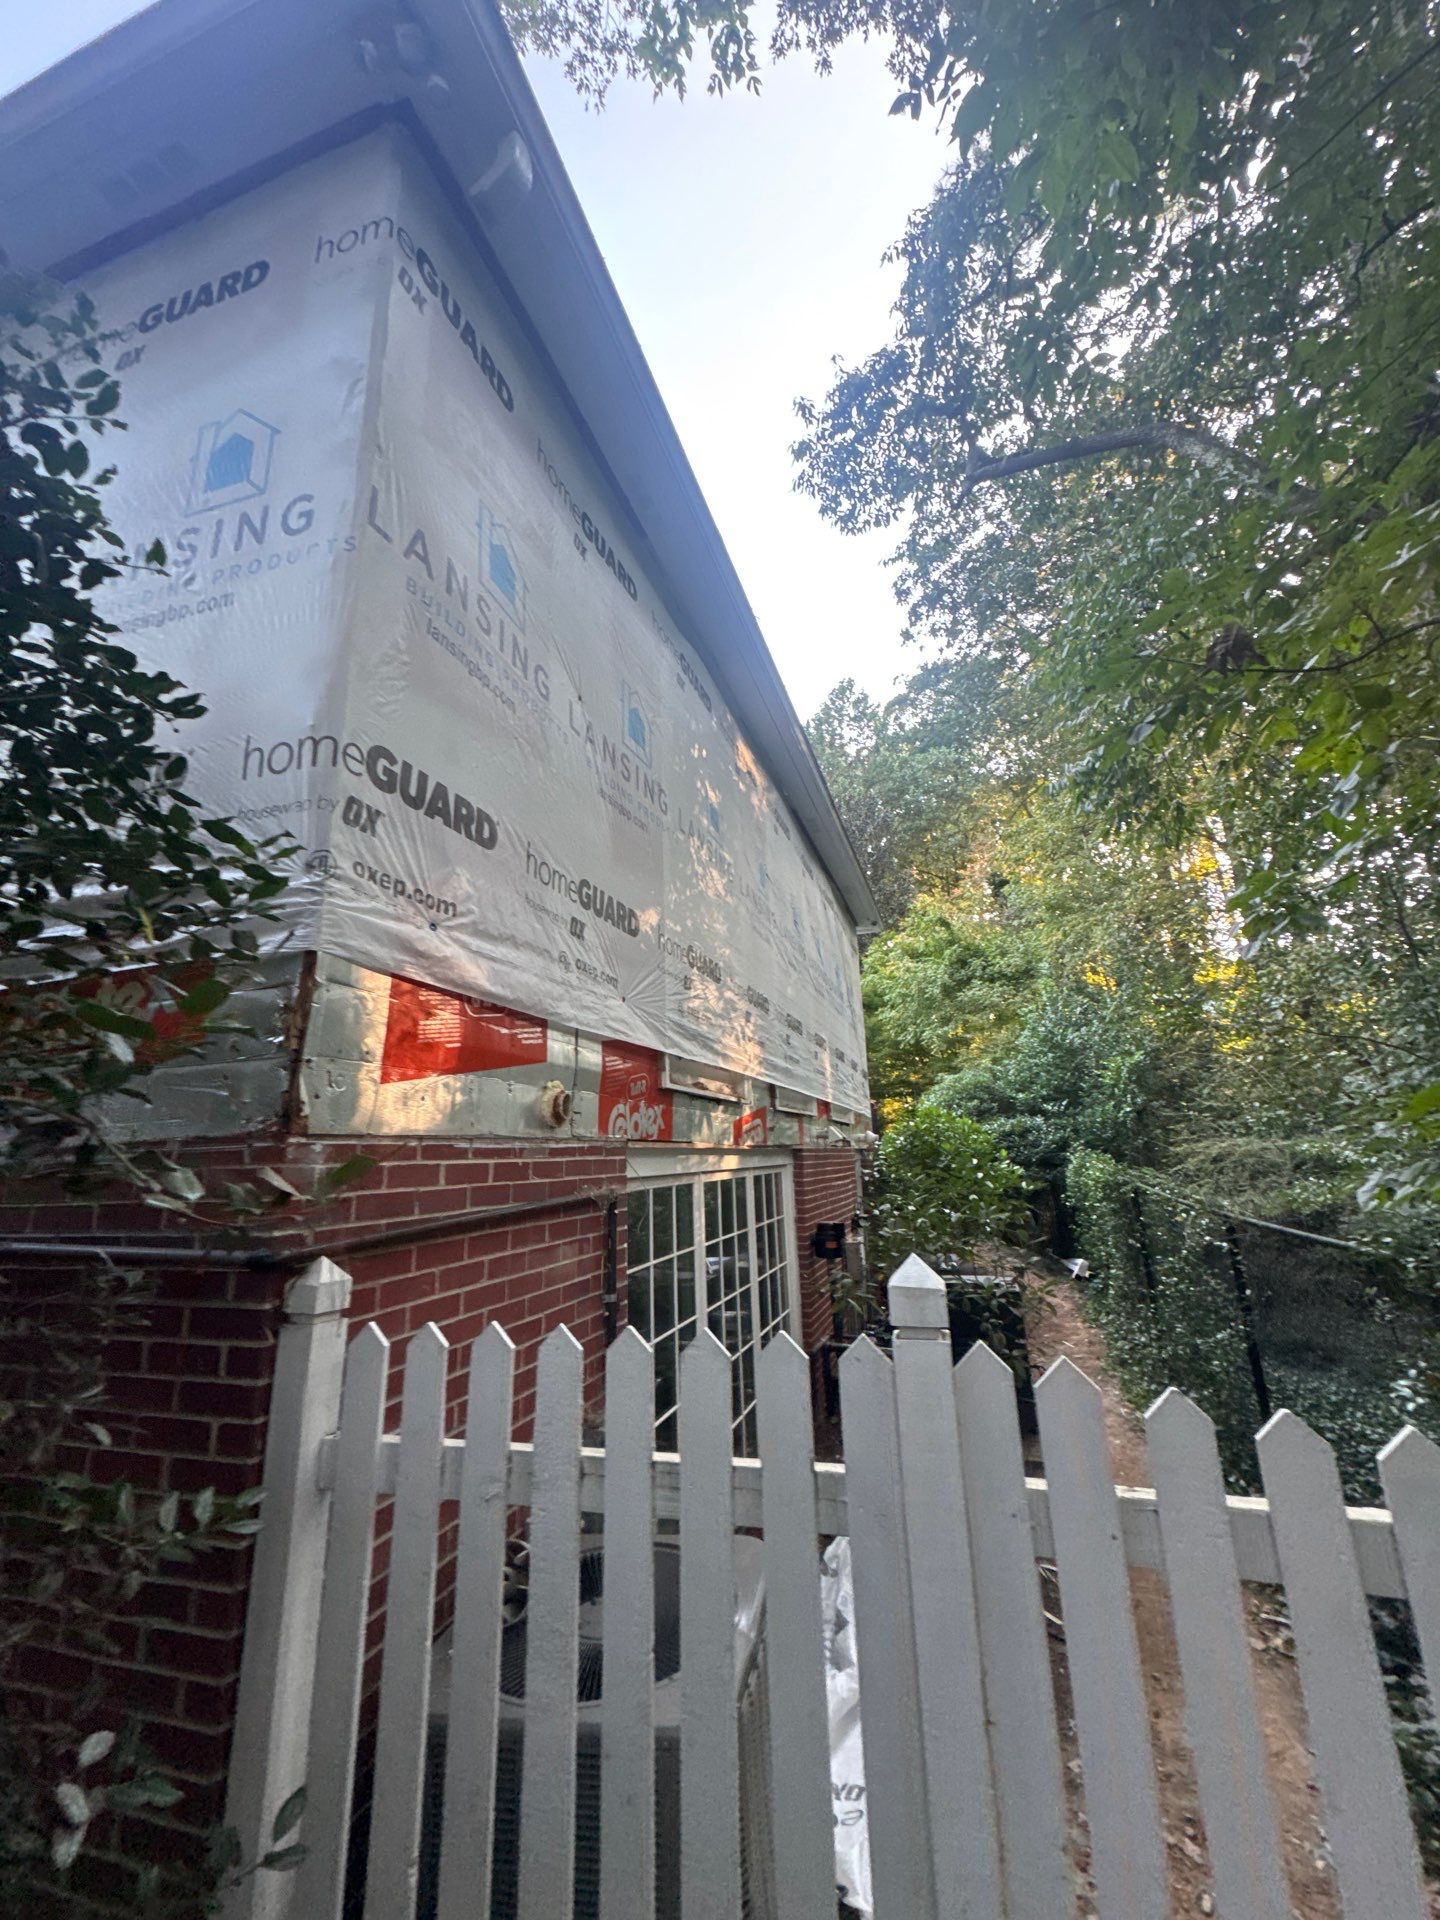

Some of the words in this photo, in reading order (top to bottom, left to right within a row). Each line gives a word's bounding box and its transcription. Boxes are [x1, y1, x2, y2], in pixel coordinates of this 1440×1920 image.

[314, 216, 515, 413] homeGUARD
[398, 266, 428, 317] OX
[537, 438, 638, 601] homeGUARD
[367, 484, 551, 702] LANSING
[242, 734, 499, 851] homeGUARD
[568, 698, 668, 817] LANSING
[342, 795, 386, 838] OX
[352, 860, 458, 918] oxep.com
[526, 841, 640, 938] homeGUARD
[569, 915, 586, 941] OX
[575, 957, 619, 989] oxep.com
